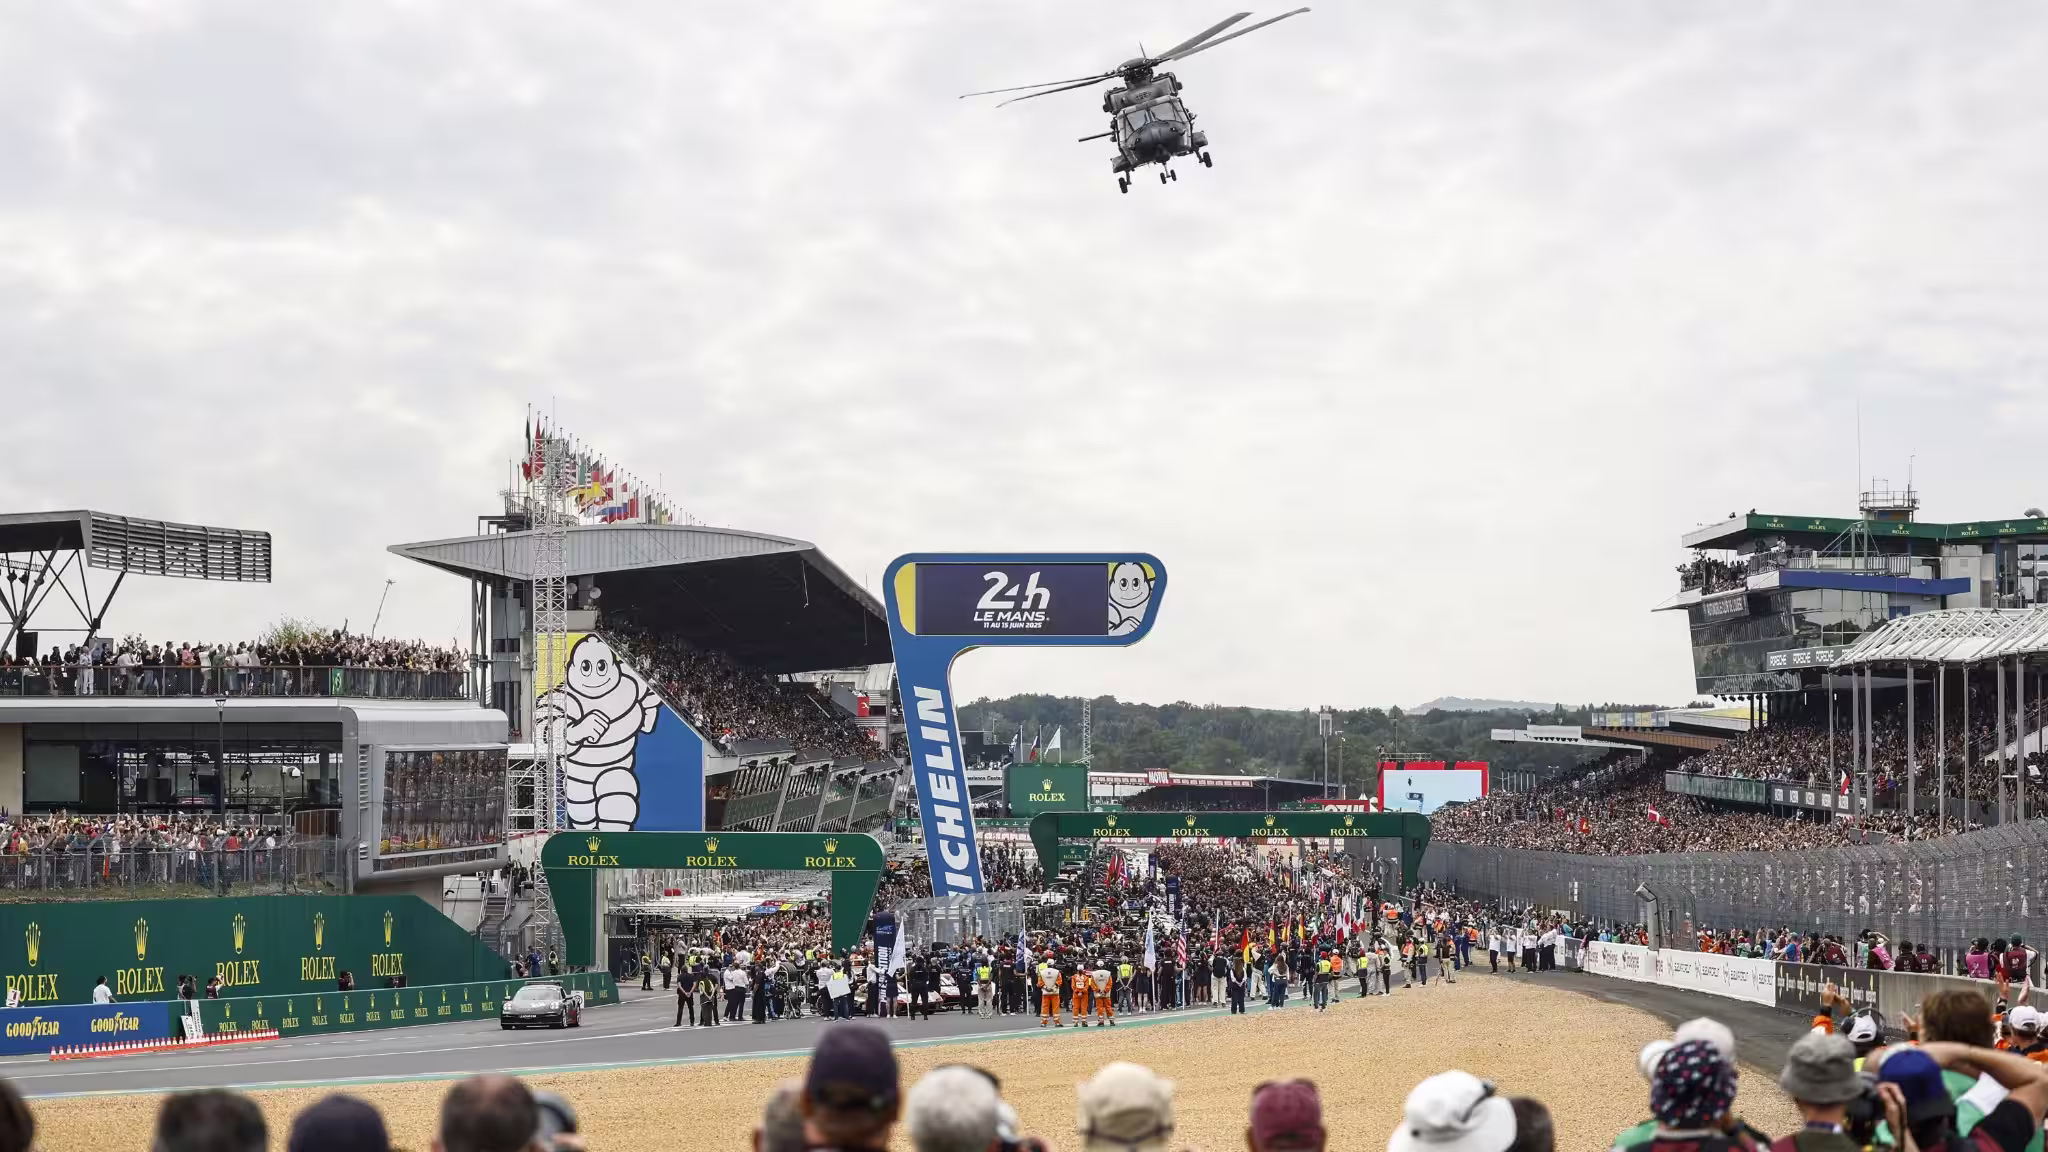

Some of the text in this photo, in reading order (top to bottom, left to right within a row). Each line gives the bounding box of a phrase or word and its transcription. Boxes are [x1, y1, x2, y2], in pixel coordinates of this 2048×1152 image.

[976, 571, 1051, 609] 24h
[974, 611, 1046, 621] LE MANS
[1009, 622, 1025, 630] JUIN
[913, 685, 975, 900] ICHELIN
[1029, 793, 1065, 802] ROLEX
[1093, 828, 1131, 837] ROLEX
[1172, 828, 1210, 837] ROLEX
[1251, 828, 1289, 837] ROLEX
[1330, 828, 1368, 837] ROLEX
[568, 856, 619, 866] ROLEX
[686, 856, 738, 867] ROLEX
[805, 857, 857, 868] ROLEX
[301, 956, 335, 981] ROLEX
[373, 953, 404, 976] ROLEX
[216, 960, 260, 987] ROLEX
[117, 966, 164, 995] ROLEX
[6, 973, 59, 1002] ROLEX
[91, 1012, 139, 1036] GOODYEAR
[283, 1018, 299, 1028] ROLEX
[312, 1015, 328, 1025] ROLEX
[6, 1017, 59, 1040] GOODYEAR
